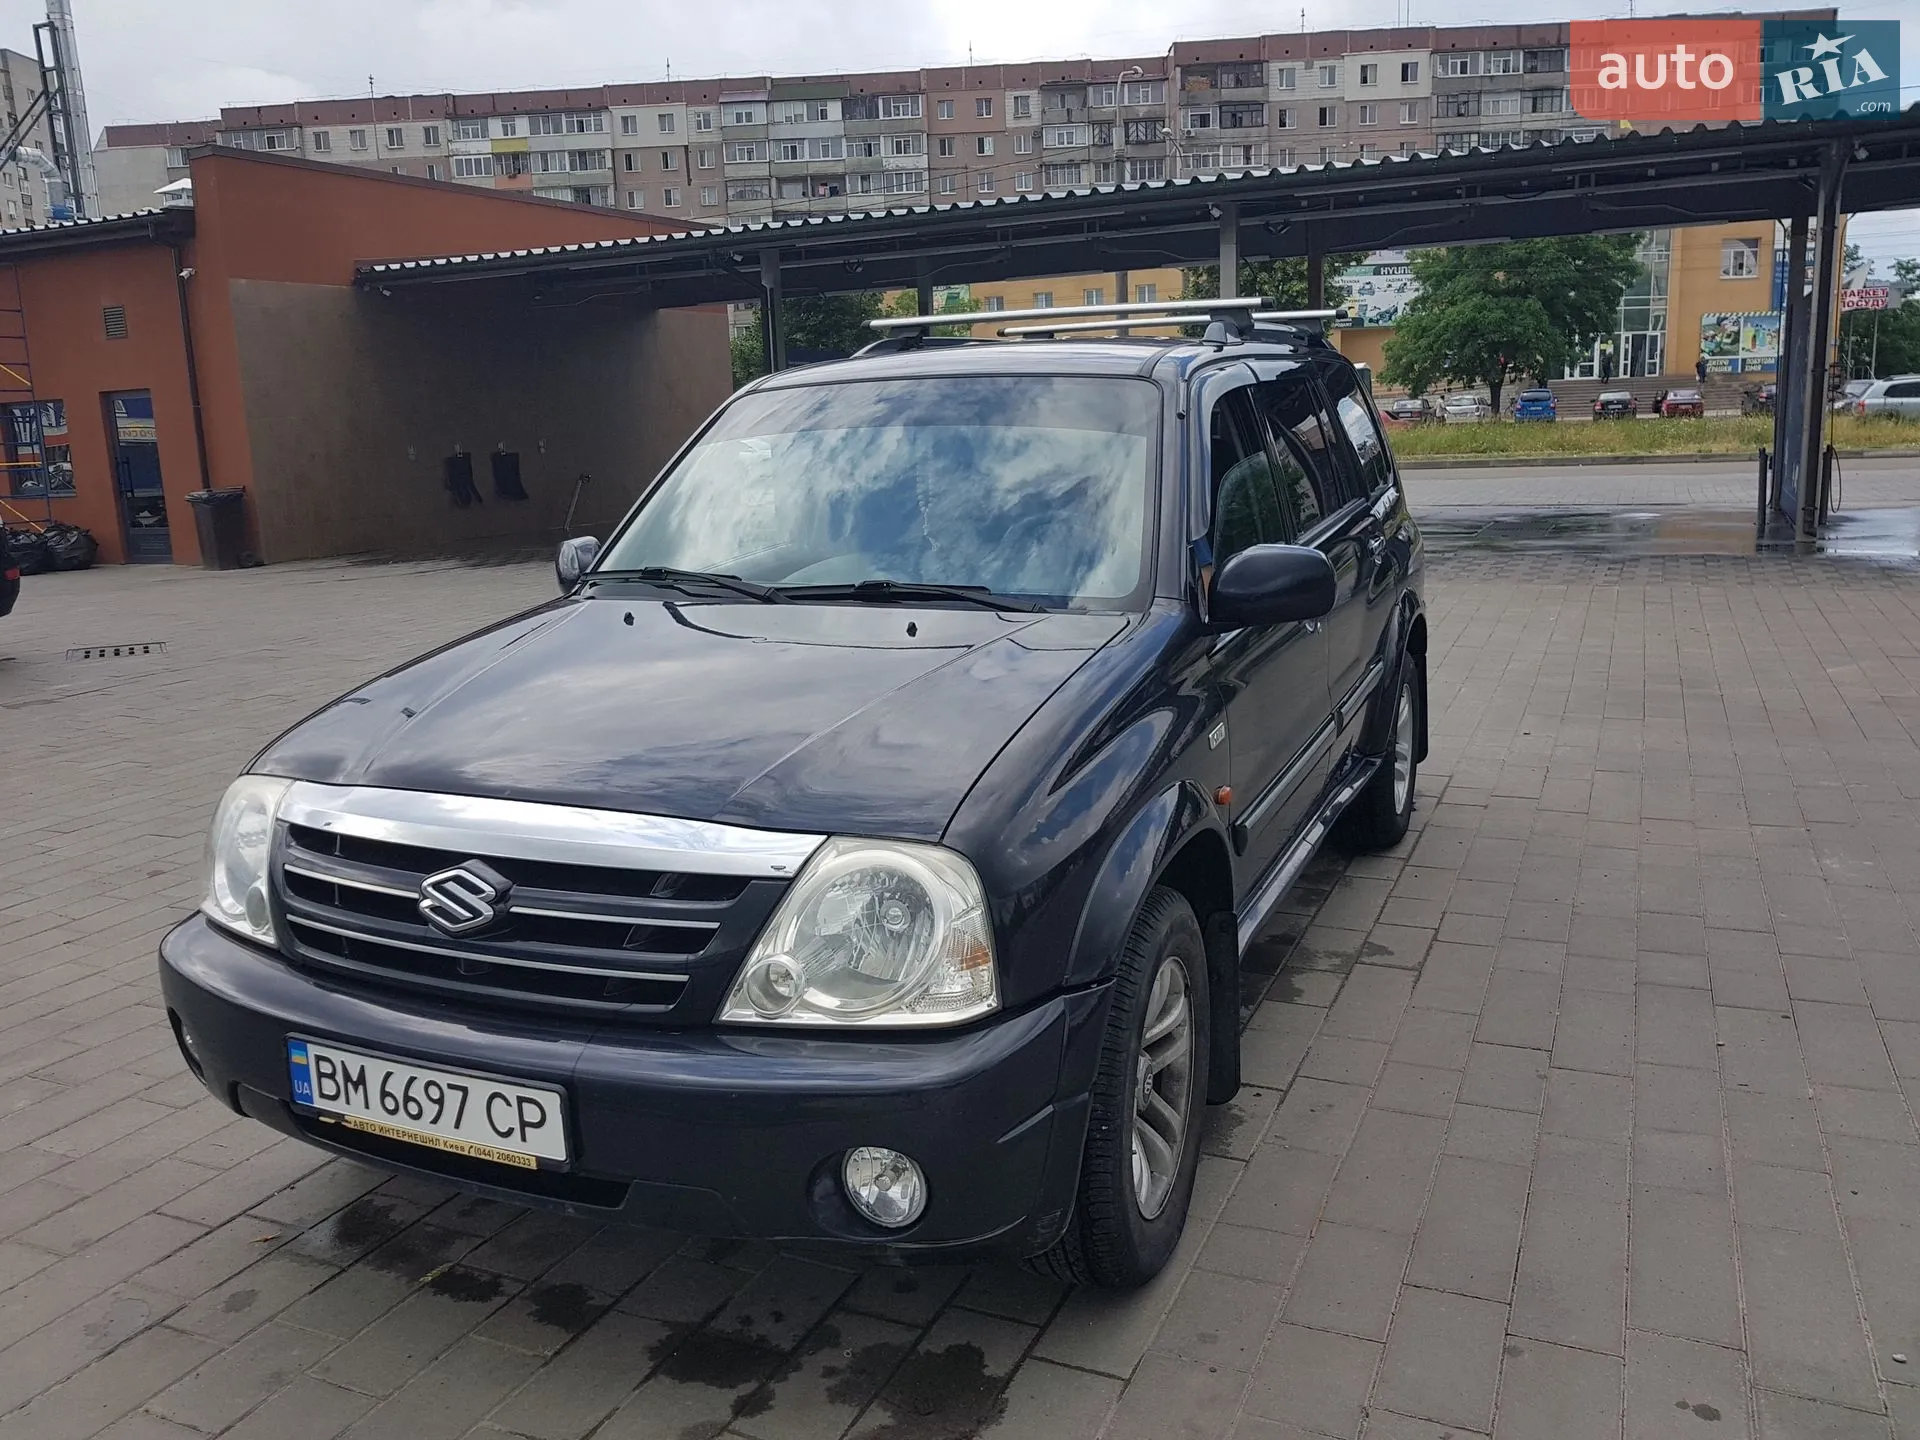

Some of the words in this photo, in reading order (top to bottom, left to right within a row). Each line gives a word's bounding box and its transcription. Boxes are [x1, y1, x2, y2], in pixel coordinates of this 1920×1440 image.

[294, 1079, 311, 1096] UA
[314, 1054, 370, 1110] BM
[380, 1070, 469, 1130] 6697
[486, 1091, 547, 1142] CP
[353, 1119, 377, 1132] АВТО
[377, 1126, 441, 1147] ИНТЕРНЕШНЛ
[443, 1140, 466, 1152] Киев
[474, 1145, 495, 1160] (044)
[496, 1151, 531, 1167] 2060333
